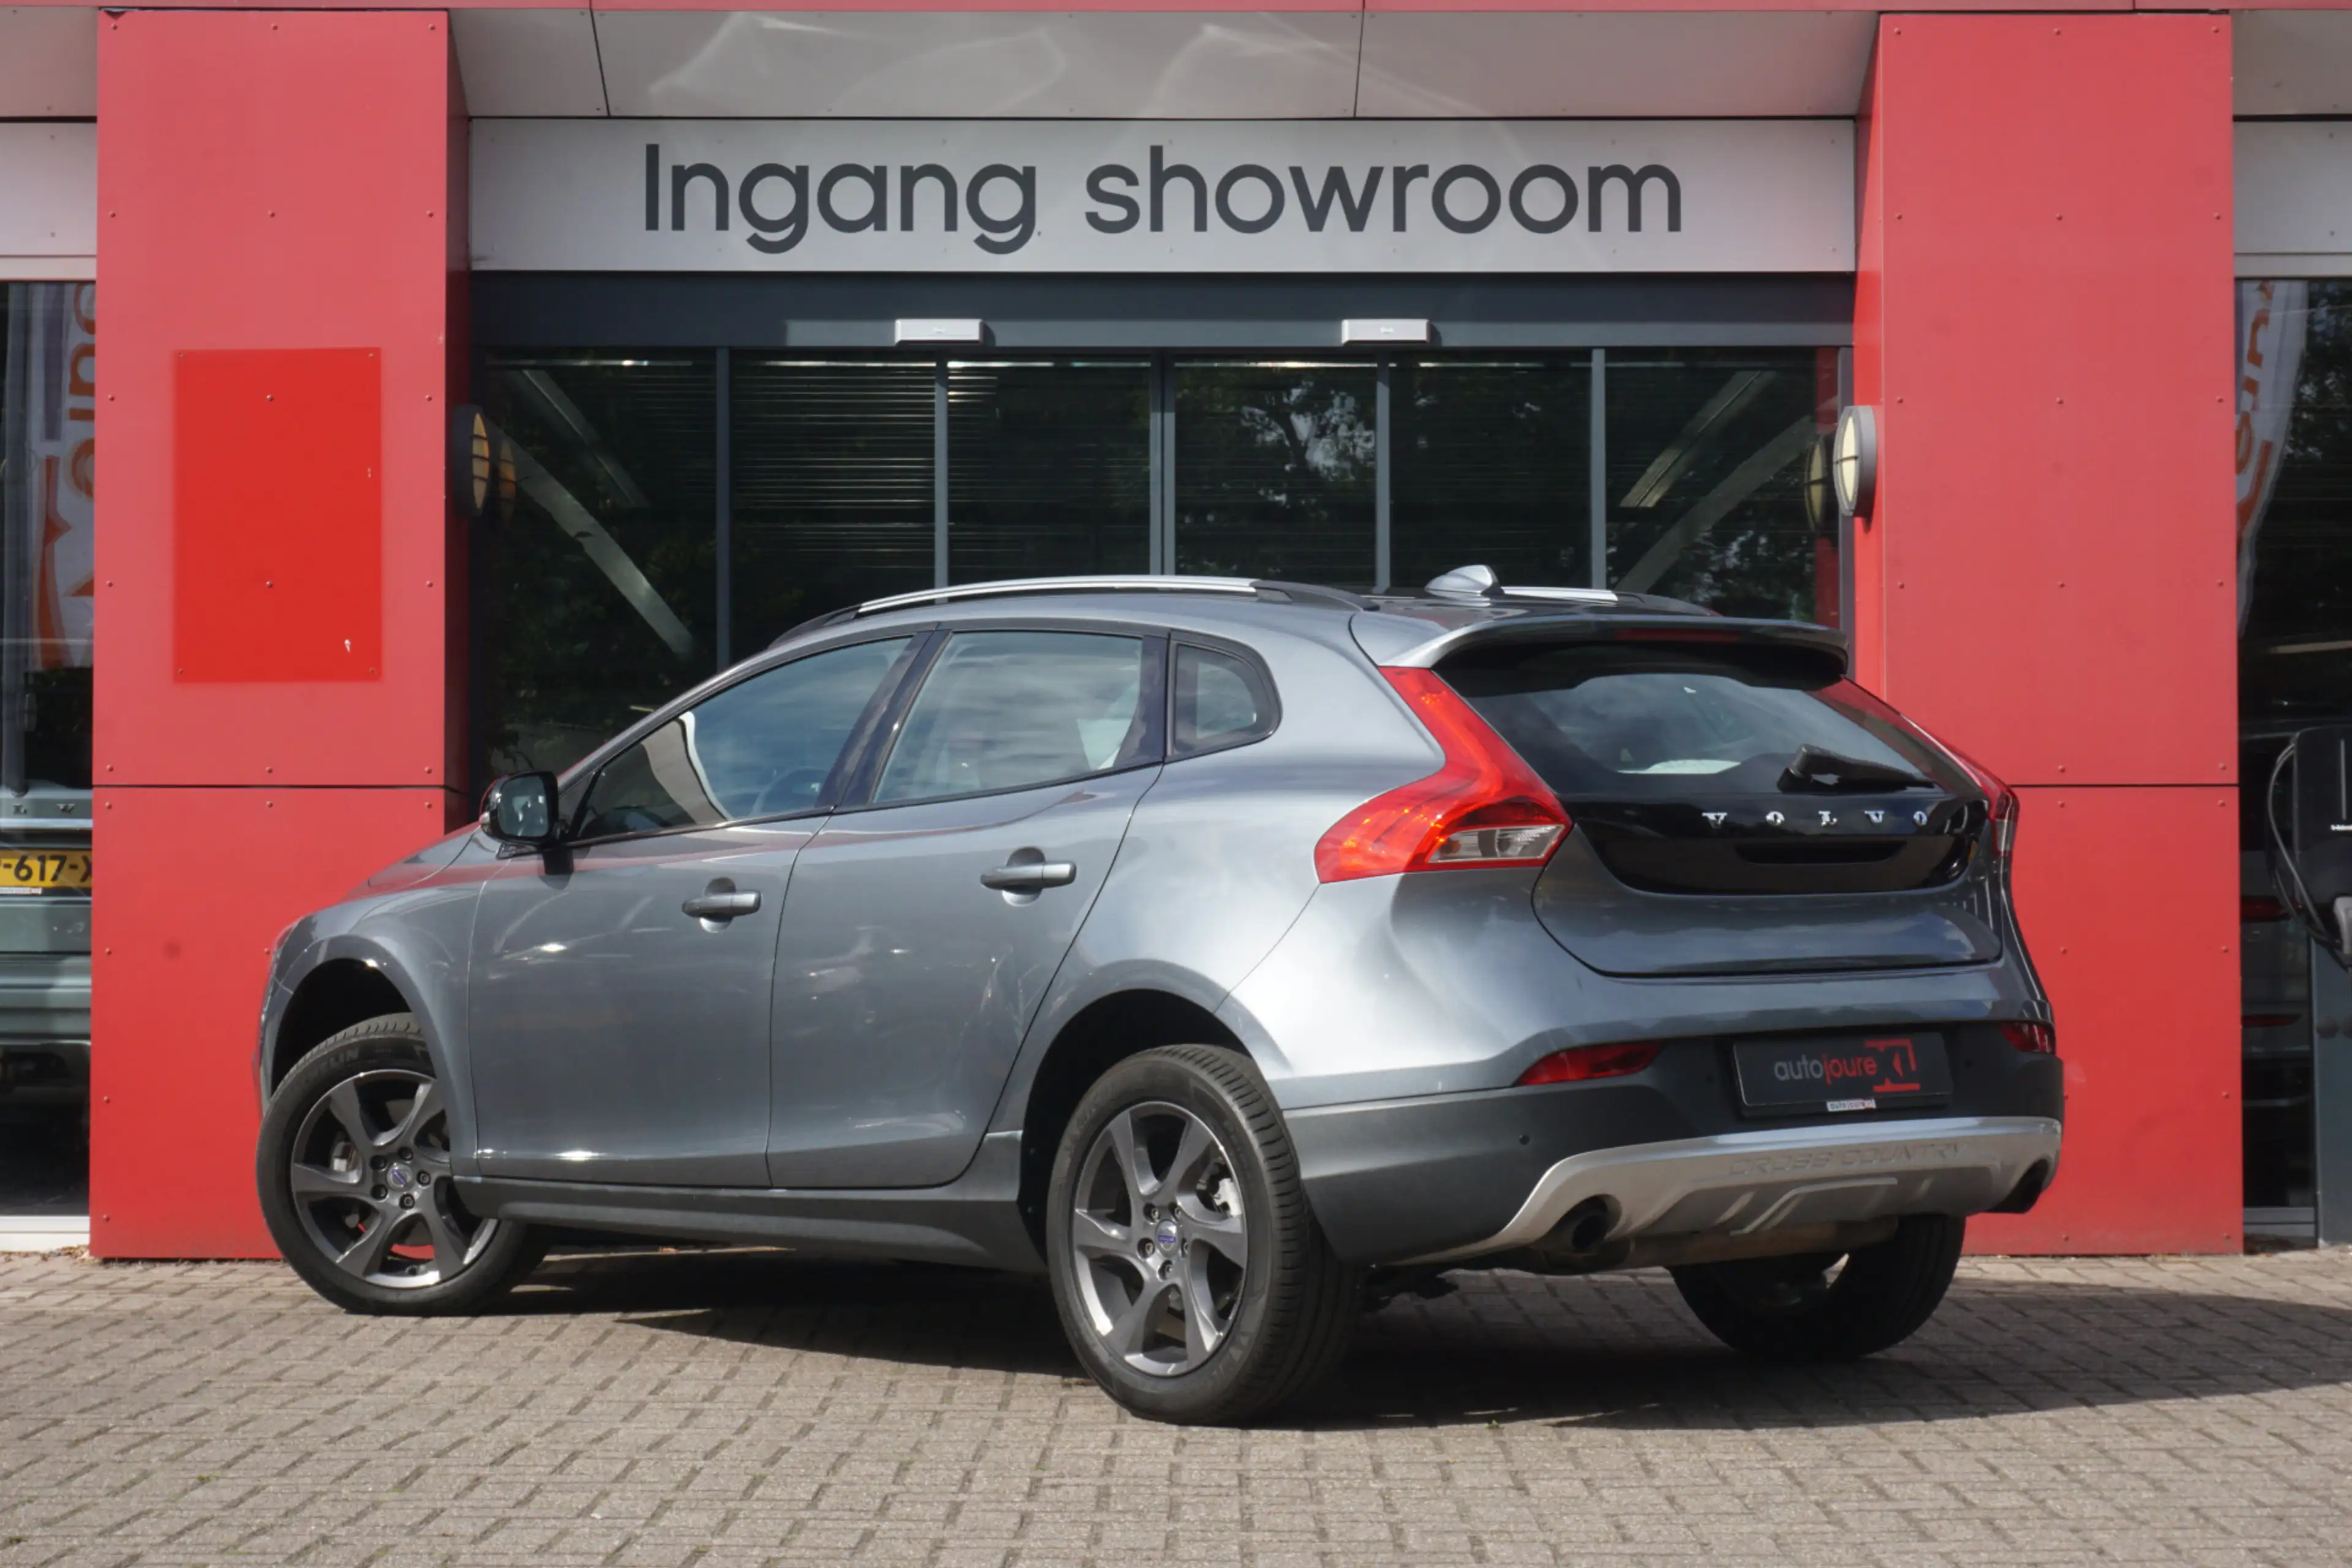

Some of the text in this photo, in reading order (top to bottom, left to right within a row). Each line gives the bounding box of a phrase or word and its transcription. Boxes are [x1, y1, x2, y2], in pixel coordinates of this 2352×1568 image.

[645, 143, 1682, 254] Ingang showroom
[1702, 810, 1928, 828] VOLVO
[1774, 1052, 1877, 1085] autojoure
